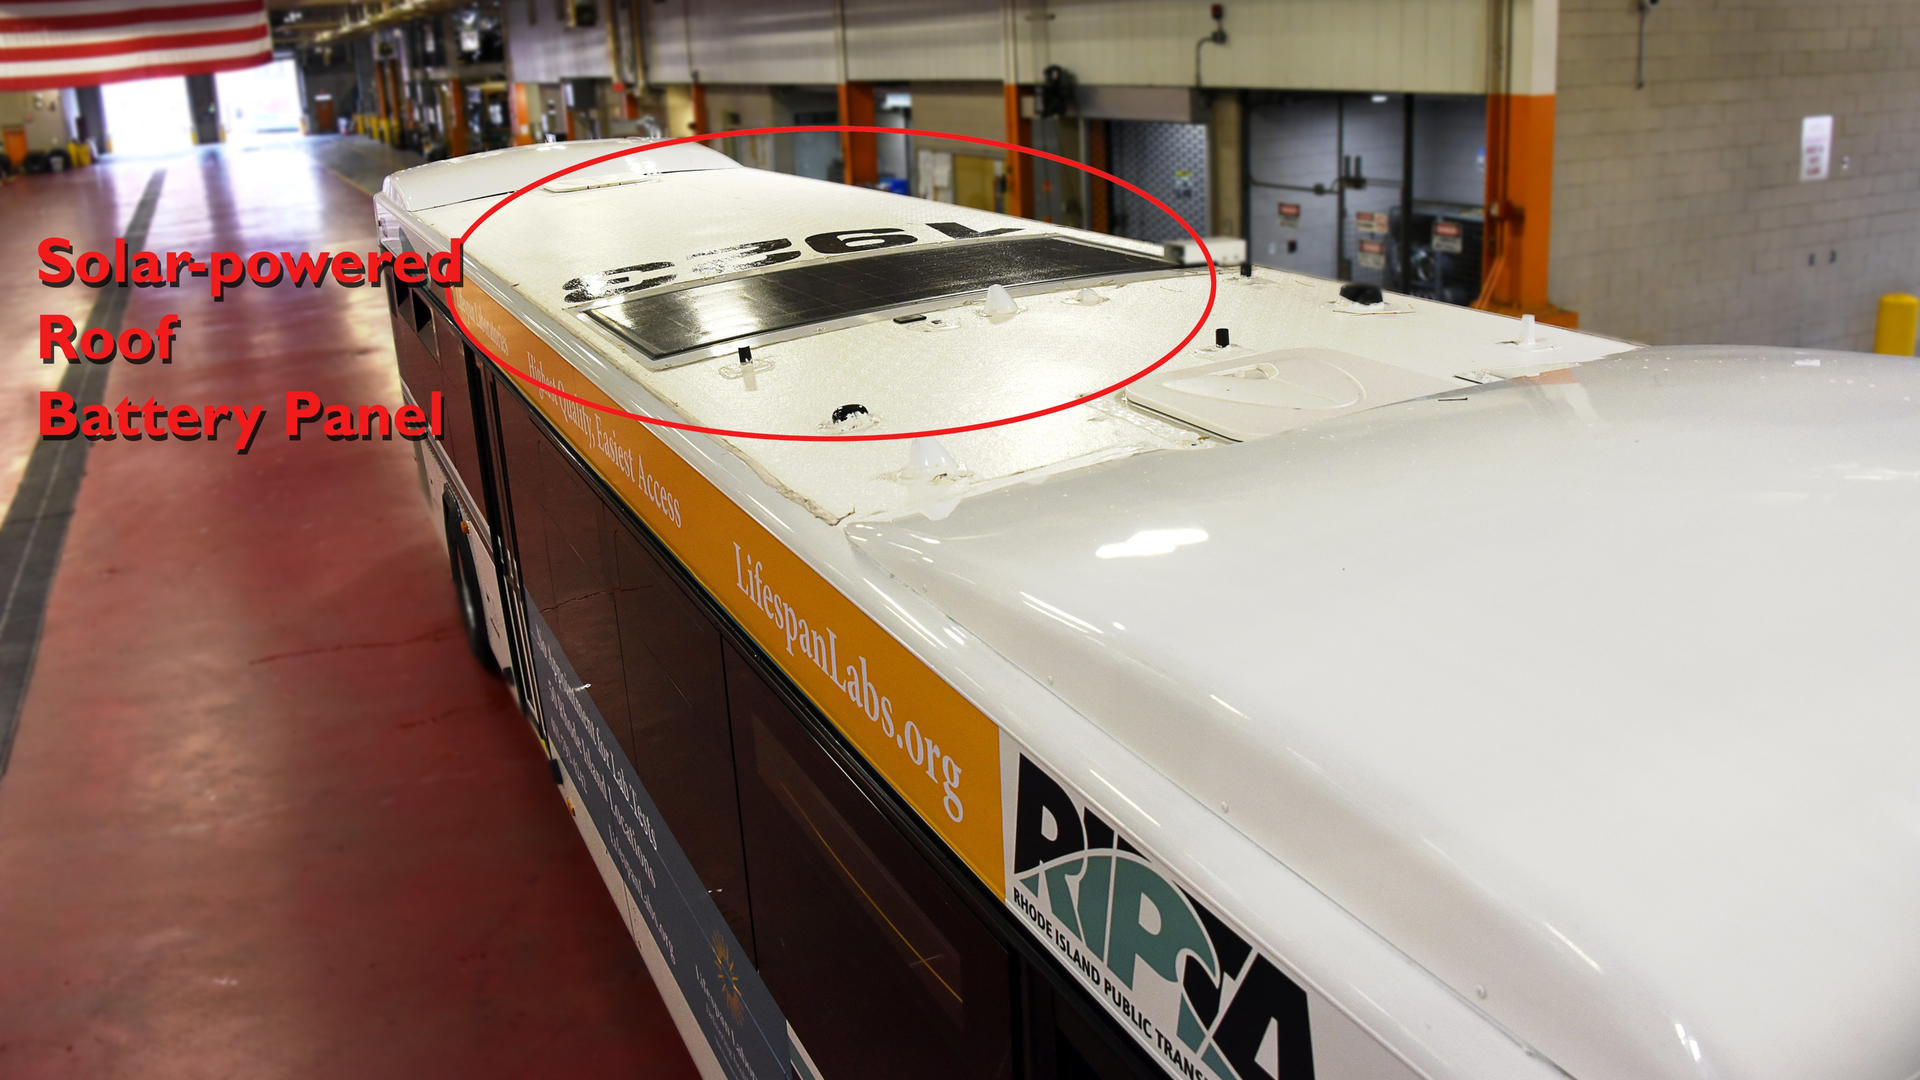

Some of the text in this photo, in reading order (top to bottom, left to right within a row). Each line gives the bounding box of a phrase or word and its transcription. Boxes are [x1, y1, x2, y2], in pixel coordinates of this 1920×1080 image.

[527, 350, 682, 529] Highest Quality, Easiest Access
[733, 541, 964, 823] LifespanLabs.org
[607, 784, 656, 889] Locations
[610, 750, 630, 802] Lab
[628, 783, 658, 851] Tests
[1013, 886, 1209, 1080] RHODE ISLAND PUBLIC TRANS
